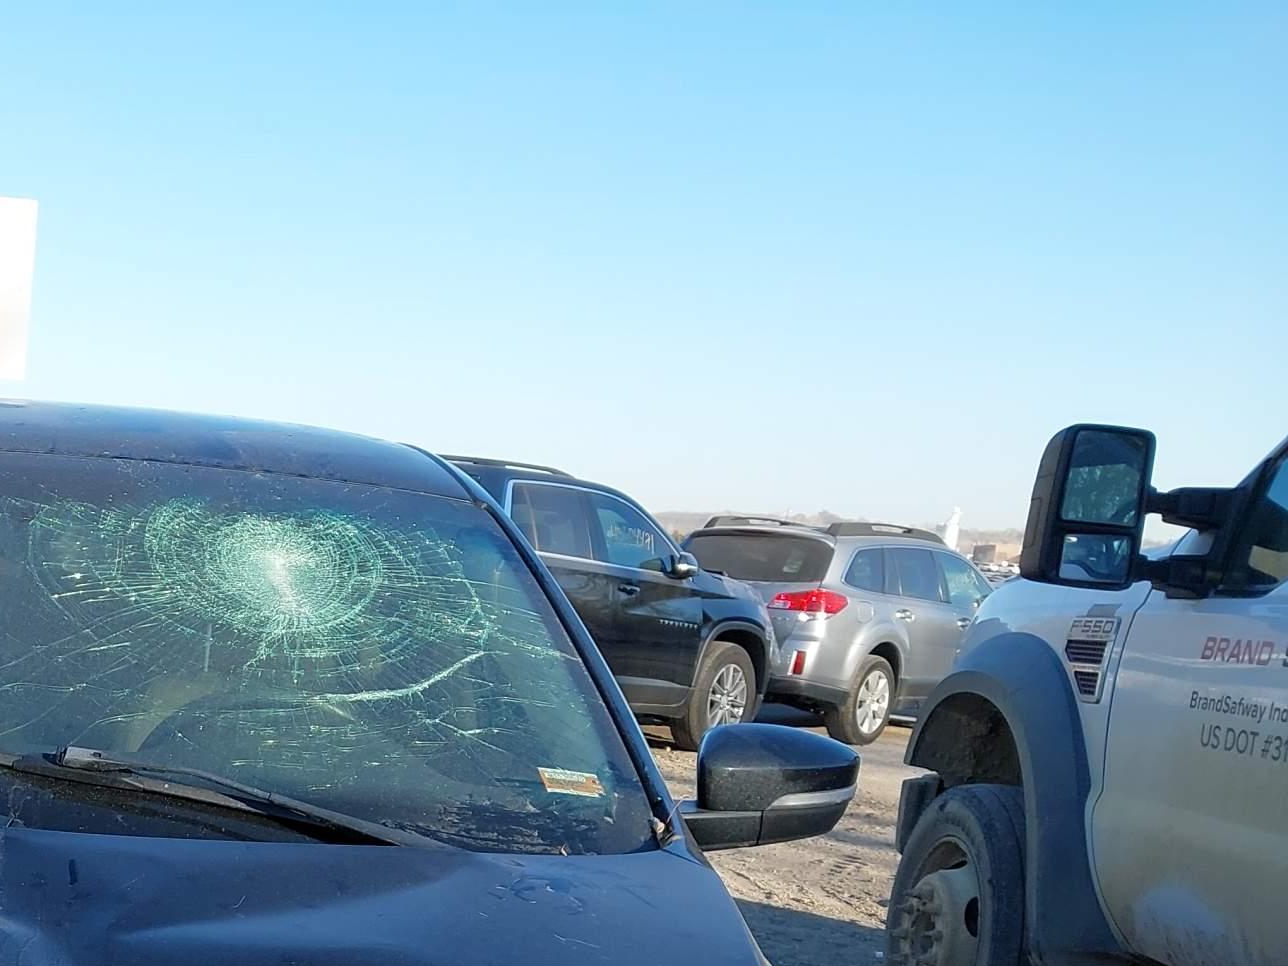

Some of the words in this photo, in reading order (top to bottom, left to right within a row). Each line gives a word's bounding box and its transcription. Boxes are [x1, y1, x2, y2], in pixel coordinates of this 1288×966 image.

[1200, 636, 1274, 666] BRAND
[1189, 690, 1267, 724] BrandSafway
[1200, 723, 1222, 749] US
[1223, 727, 1260, 756] DOT
